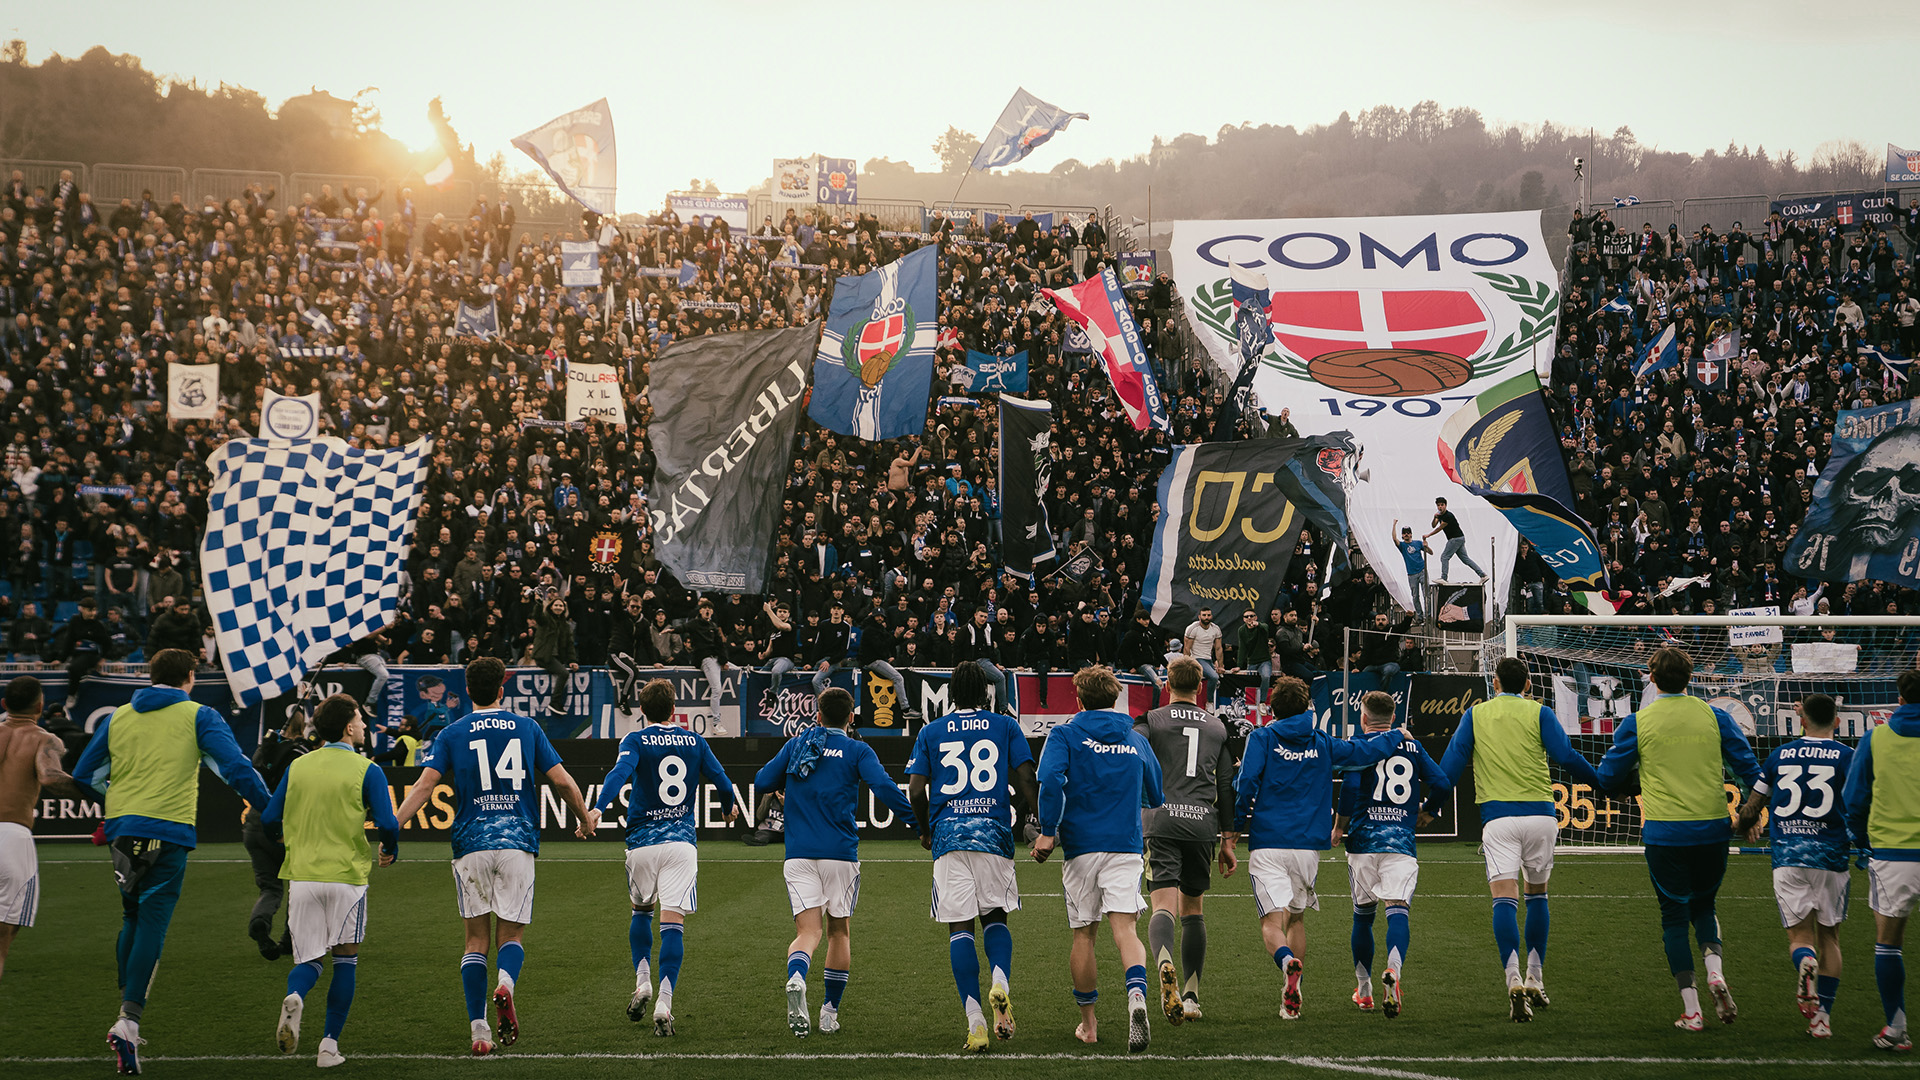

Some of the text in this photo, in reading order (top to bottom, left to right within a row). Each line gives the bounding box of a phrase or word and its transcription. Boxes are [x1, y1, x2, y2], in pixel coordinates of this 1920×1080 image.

[822, 160, 856, 175] 1 9
[1890, 173, 1900, 181] SE
[819, 186, 856, 202] 0 7
[695, 201, 746, 210] GURDONA
[1196, 231, 1530, 272] COMO
[1602, 244, 1633, 255] MINGA
[586, 389, 610, 399] X IL
[579, 407, 617, 417] COMO
[516, 672, 590, 696] COO
[500, 694, 590, 717] MCMII
[1170, 709, 1207, 723] BUTEZ
[469, 718, 516, 733] JACOBO
[947, 718, 989, 733] A. DIAO
[641, 734, 697, 747] S.ROBERTO
[822, 748, 843, 759] IMA
[1093, 744, 1138, 756] OPTIMA
[1182, 726, 1199, 778] 1
[1283, 749, 1319, 762] OPTMA
[1779, 746, 1841, 760] DA CUNHA
[469, 738, 526, 791] 14
[939, 739, 999, 795] 38
[658, 755, 687, 806] 8
[1372, 755, 1414, 805] 18
[1773, 765, 1836, 818] 33
[473, 794, 521, 805] NEUBERGER
[947, 797, 998, 807] NEUBERGER
[32, 798, 106, 819] ERM
[481, 803, 514, 812] BERMAN
[953, 806, 990, 814] BERMAN
[1162, 802, 1210, 814] NEUBERGER
[1366, 806, 1408, 817] UBERGER
[1169, 810, 1204, 820] BERMAN
[1369, 814, 1402, 822] BERMAN
